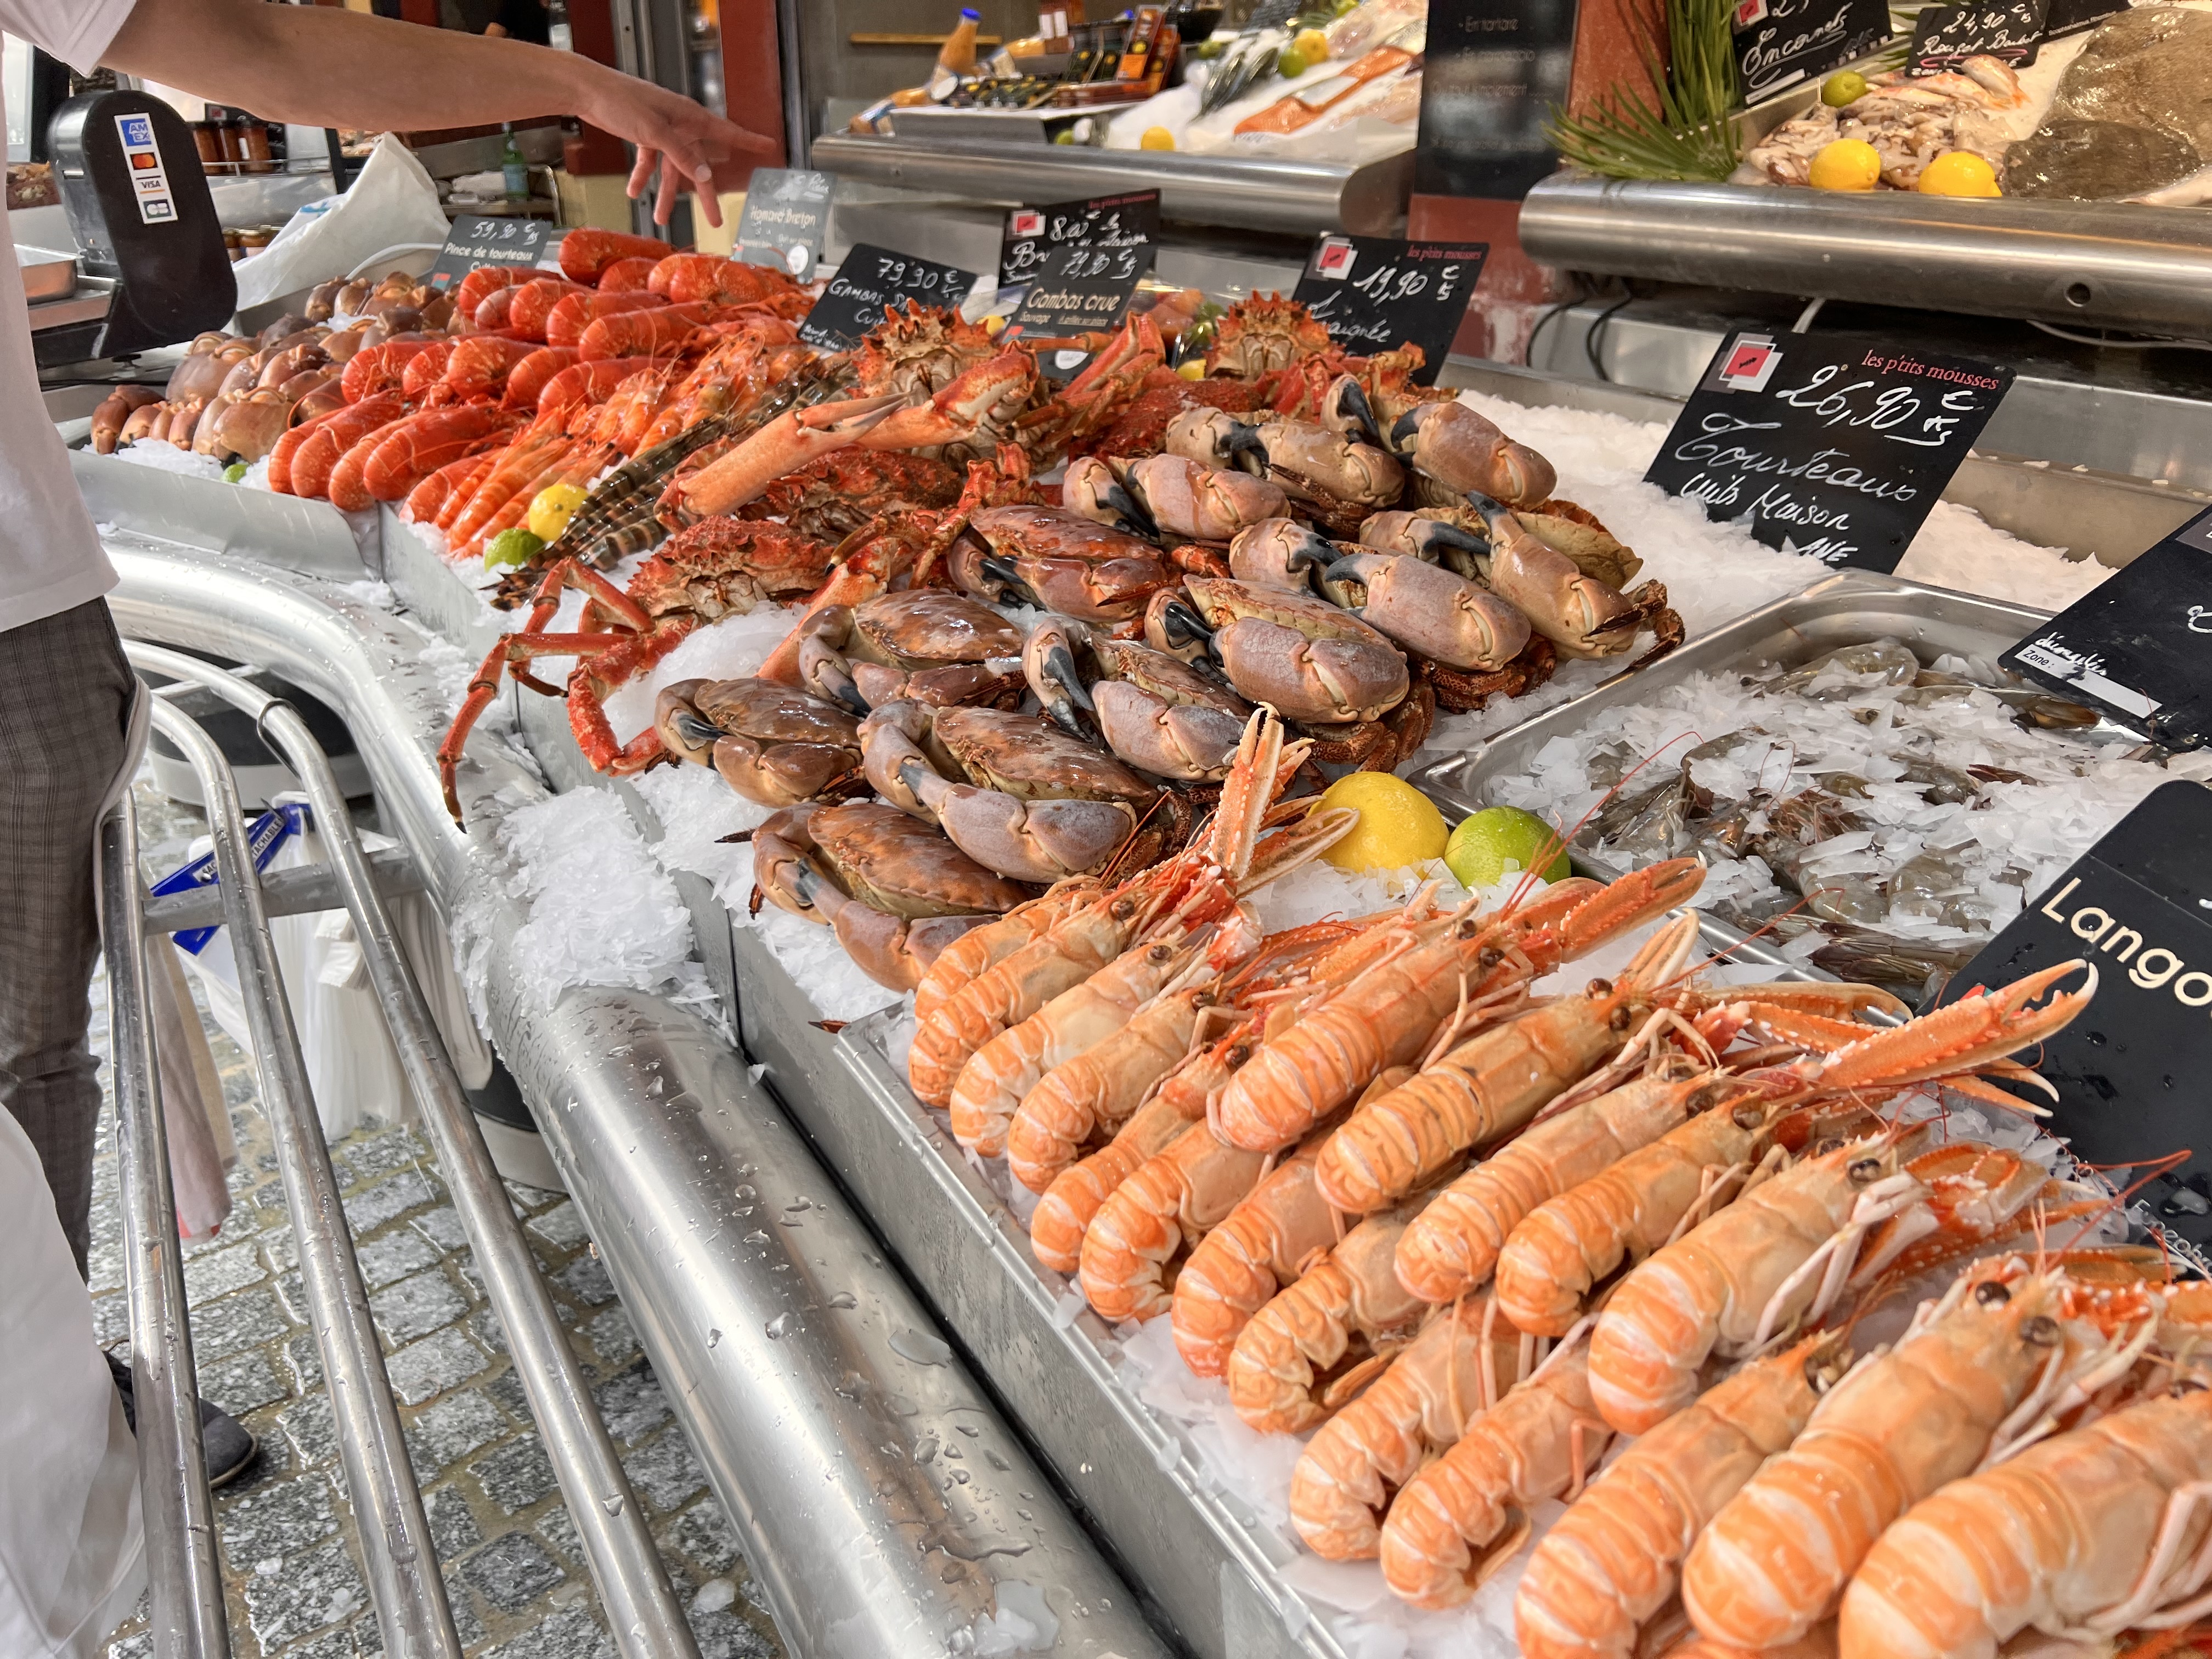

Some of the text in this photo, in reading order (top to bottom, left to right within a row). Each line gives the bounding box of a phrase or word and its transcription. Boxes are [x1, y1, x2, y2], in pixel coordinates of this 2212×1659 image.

[140, 180, 161, 188] VISA
[470, 221, 517, 240] 59,90
[444, 242, 534, 262] Pince de tourteaux
[1026, 286, 1121, 312] Gambas crue
[1861, 348, 2000, 390] les p'tits mousses
[1775, 365, 1920, 430] 26,90
[2041, 877, 2212, 1007] Lango
